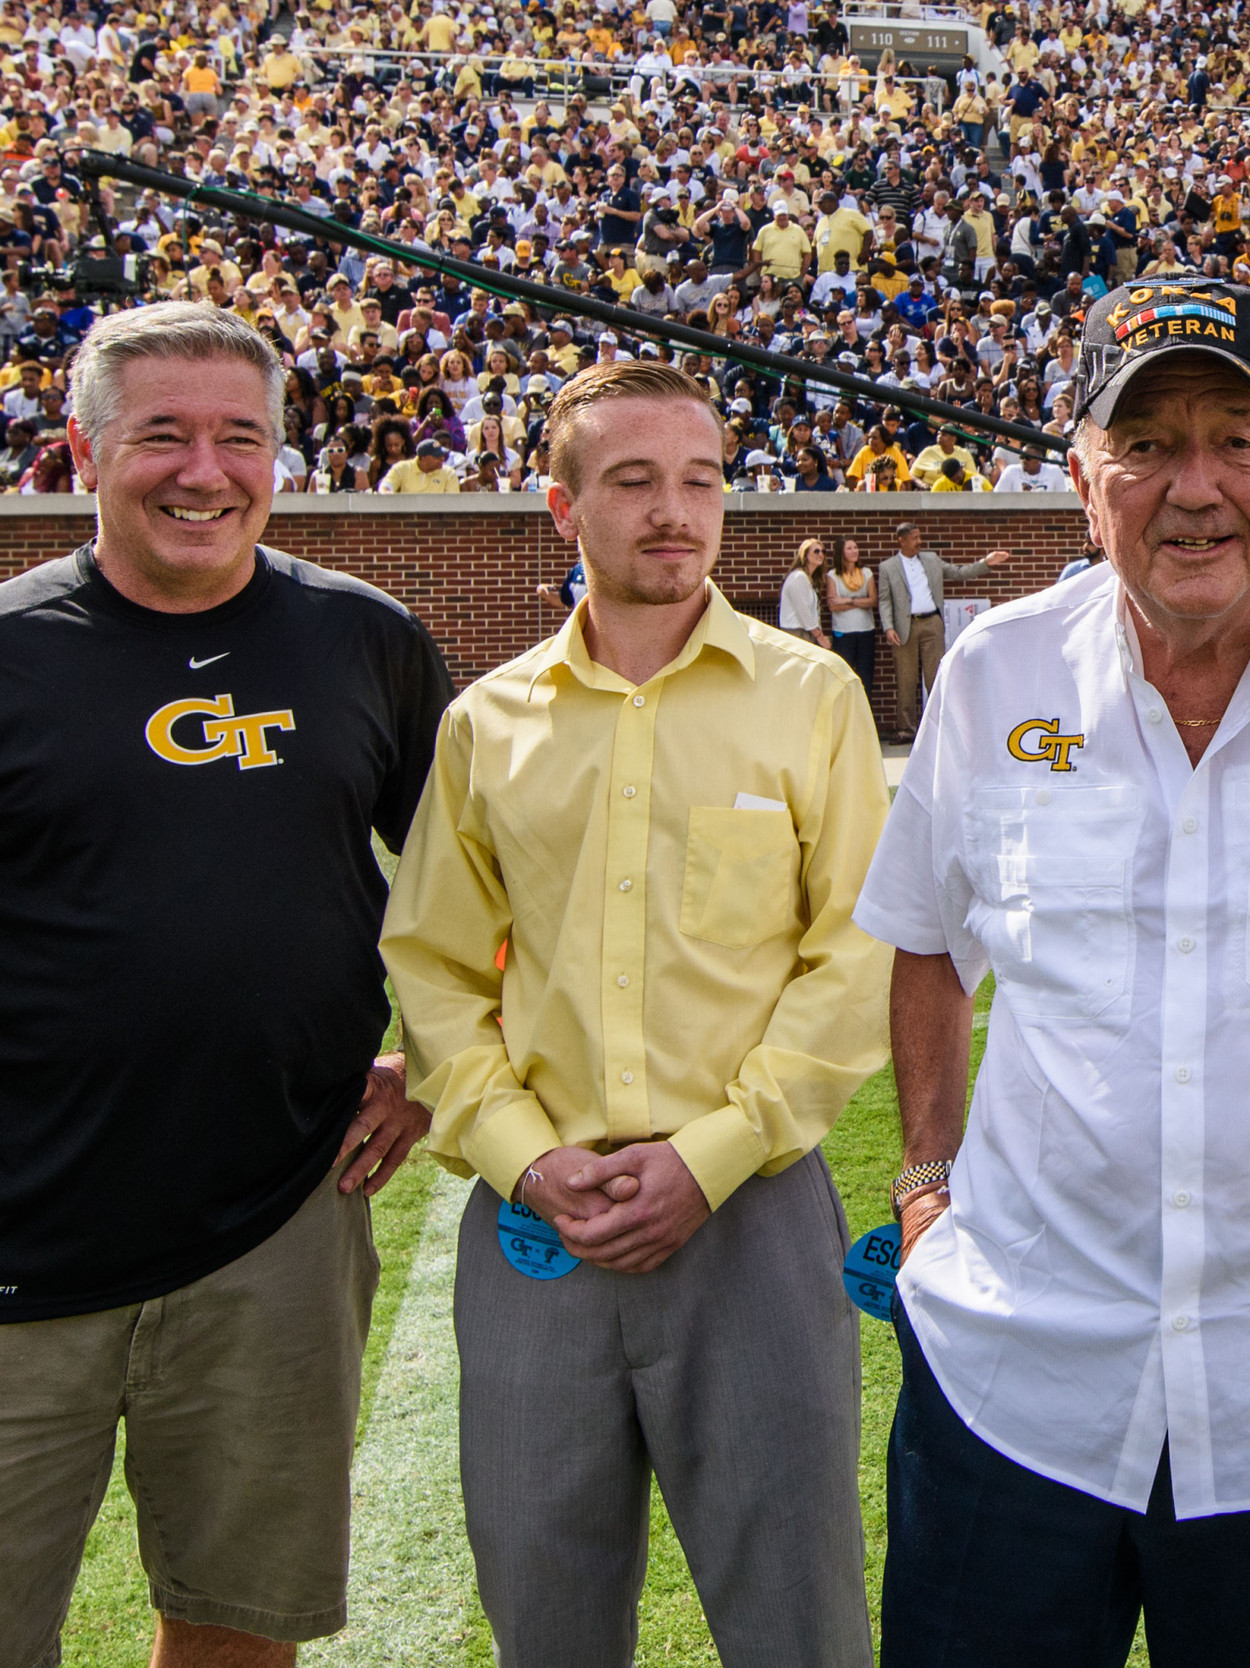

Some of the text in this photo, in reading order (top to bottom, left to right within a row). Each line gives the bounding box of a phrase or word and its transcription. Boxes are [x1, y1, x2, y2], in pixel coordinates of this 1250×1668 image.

[871, 32, 947, 48] 110 111
[1120, 319, 1236, 353] VETERAN
[145, 693, 296, 770] GT
[1007, 718, 1084, 772] GT
